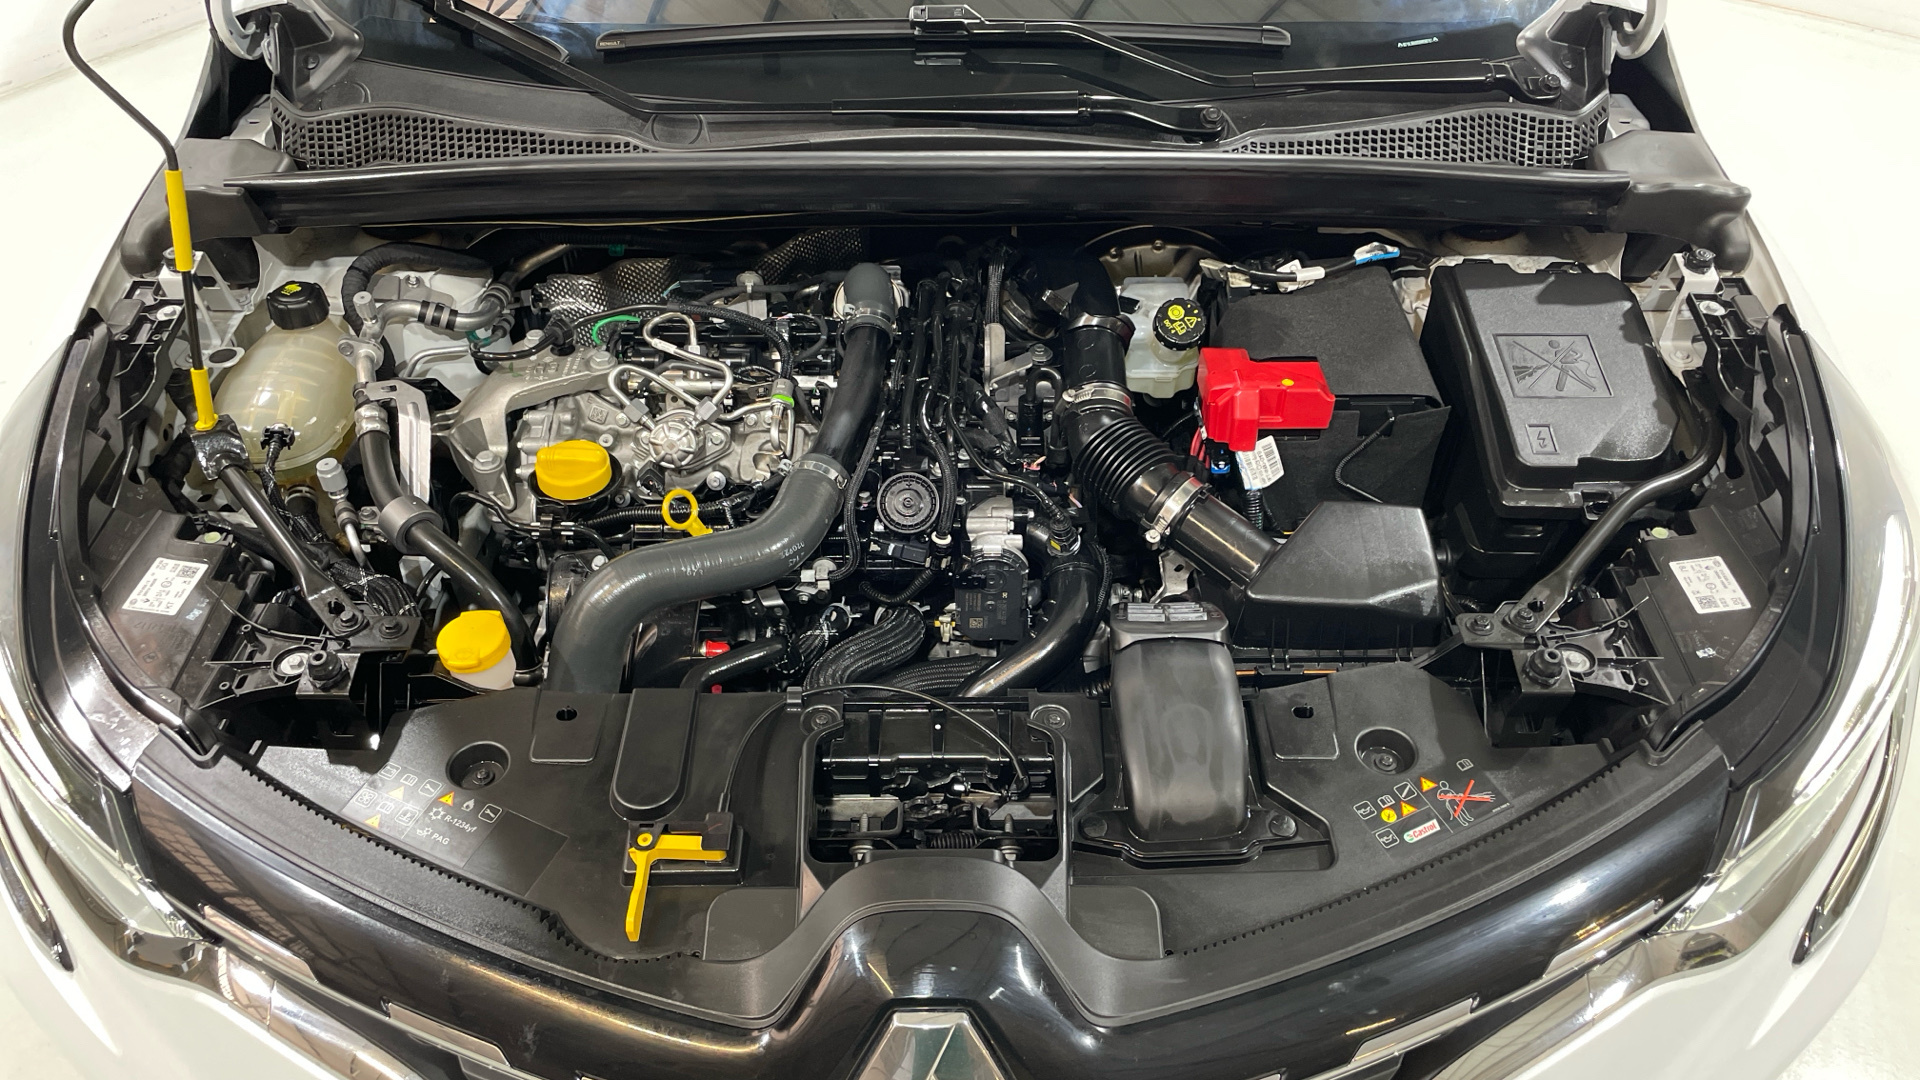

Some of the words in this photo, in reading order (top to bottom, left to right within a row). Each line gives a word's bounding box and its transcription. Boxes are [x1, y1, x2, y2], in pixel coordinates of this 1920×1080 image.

[1163, 319, 1173, 330] DOT
[443, 814, 478, 833] R-1234yf
[1412, 821, 1437, 839] Castrol
[430, 833, 450, 845] PAG
